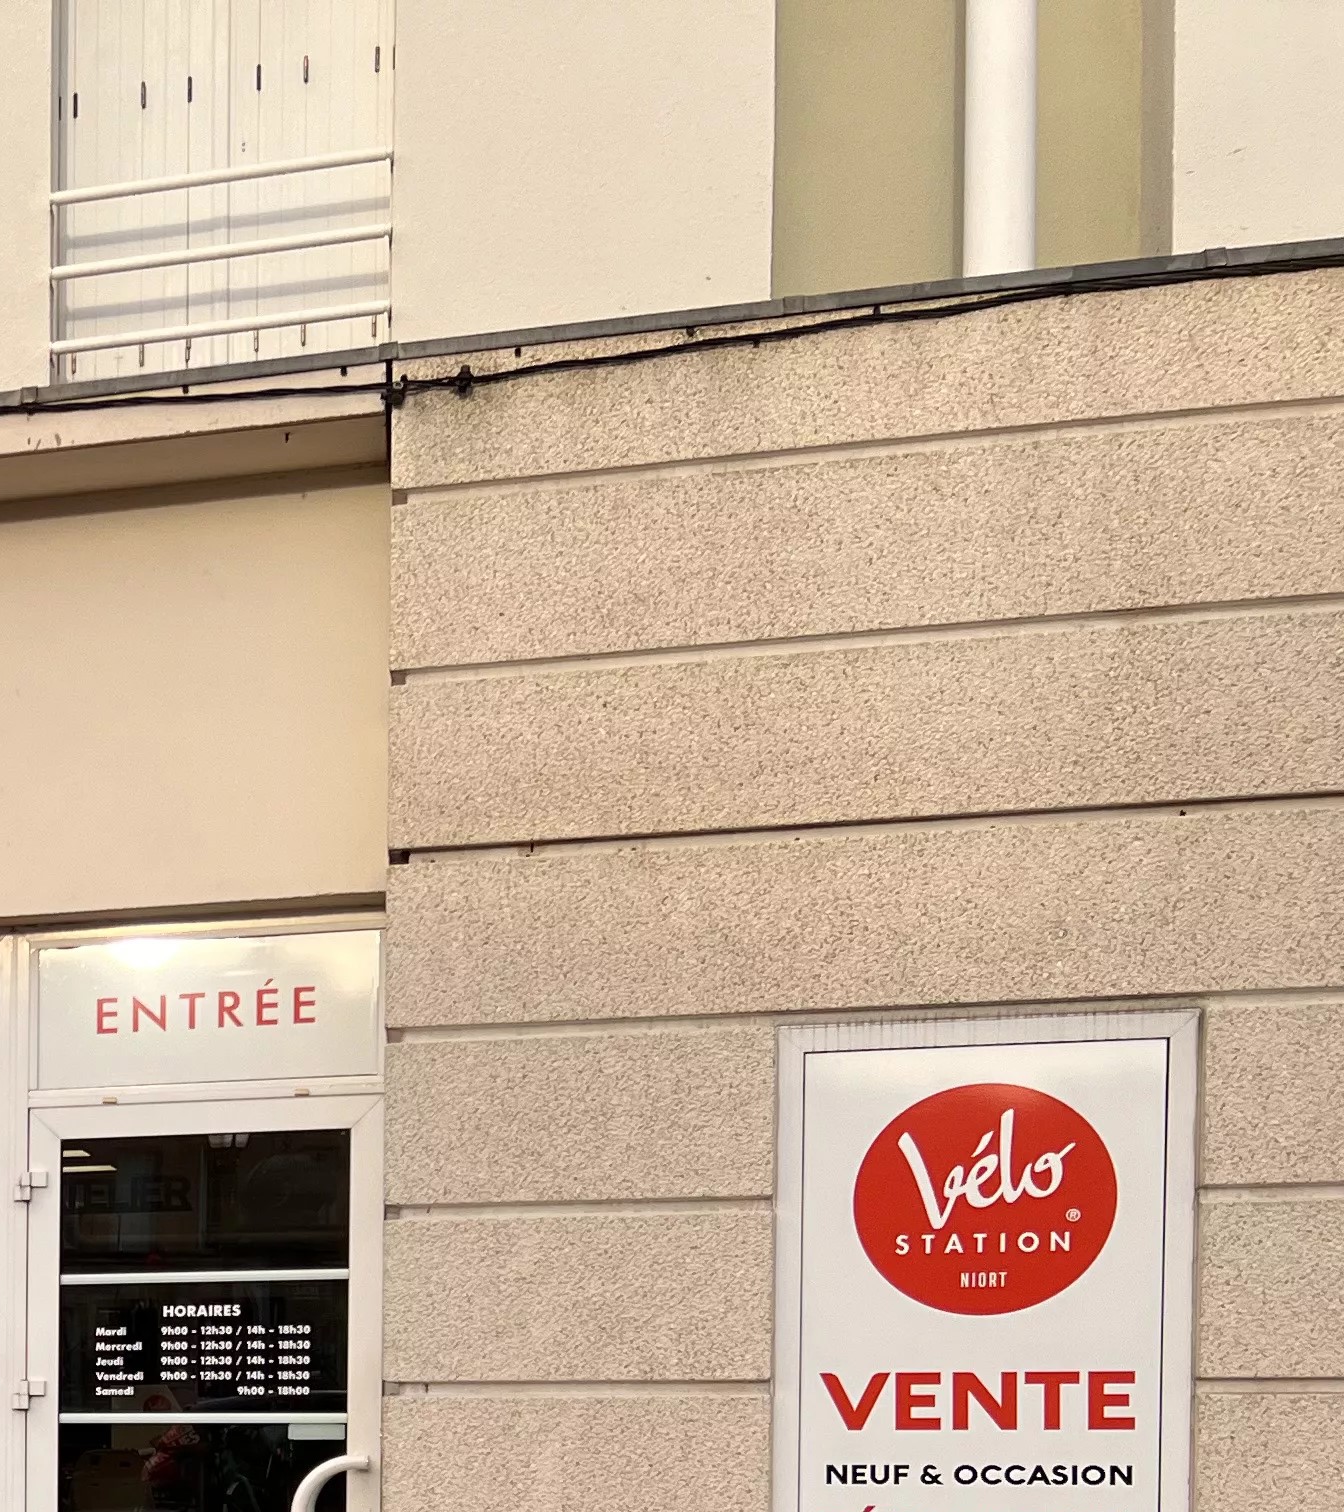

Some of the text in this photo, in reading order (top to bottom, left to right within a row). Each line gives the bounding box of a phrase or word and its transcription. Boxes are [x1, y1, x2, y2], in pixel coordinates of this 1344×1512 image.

[96, 978, 317, 1035] ENTRÉE
[897, 1108, 1077, 1229] Vélo
[895, 1231, 1071, 1255] STATION
[960, 1271, 1008, 1288] NIORT
[162, 1304, 242, 1318] HORAIRES
[95, 1327, 127, 1336] Mardi
[160, 1326, 188, 1336] 9h00
[200, 1326, 233, 1335] 12h30
[246, 1325, 266, 1335] 14h
[278, 1325, 311, 1335] 18h30
[95, 1342, 143, 1351] Mercredi
[160, 1341, 188, 1351] 9h00
[200, 1341, 233, 1350] 12h30
[246, 1340, 265, 1350] 14h
[277, 1340, 311, 1350] 18h30
[95, 1356, 124, 1367] Jeudi
[160, 1356, 188, 1366] 9h00
[199, 1356, 232, 1366] 12h30
[246, 1356, 265, 1365] 14h
[277, 1356, 310, 1365] 18h30
[95, 1372, 144, 1381] Vendredi
[159, 1371, 187, 1381] 9h00
[199, 1371, 232, 1381] 12h30
[245, 1371, 264, 1381] 14h
[276, 1371, 310, 1380] 18h30
[95, 1386, 134, 1396] Samedi
[237, 1386, 265, 1396] 9h00
[277, 1386, 310, 1396] 18h00
[819, 1371, 1136, 1430] VENTE
[825, 1464, 1133, 1486] NEUF & OCCASION
